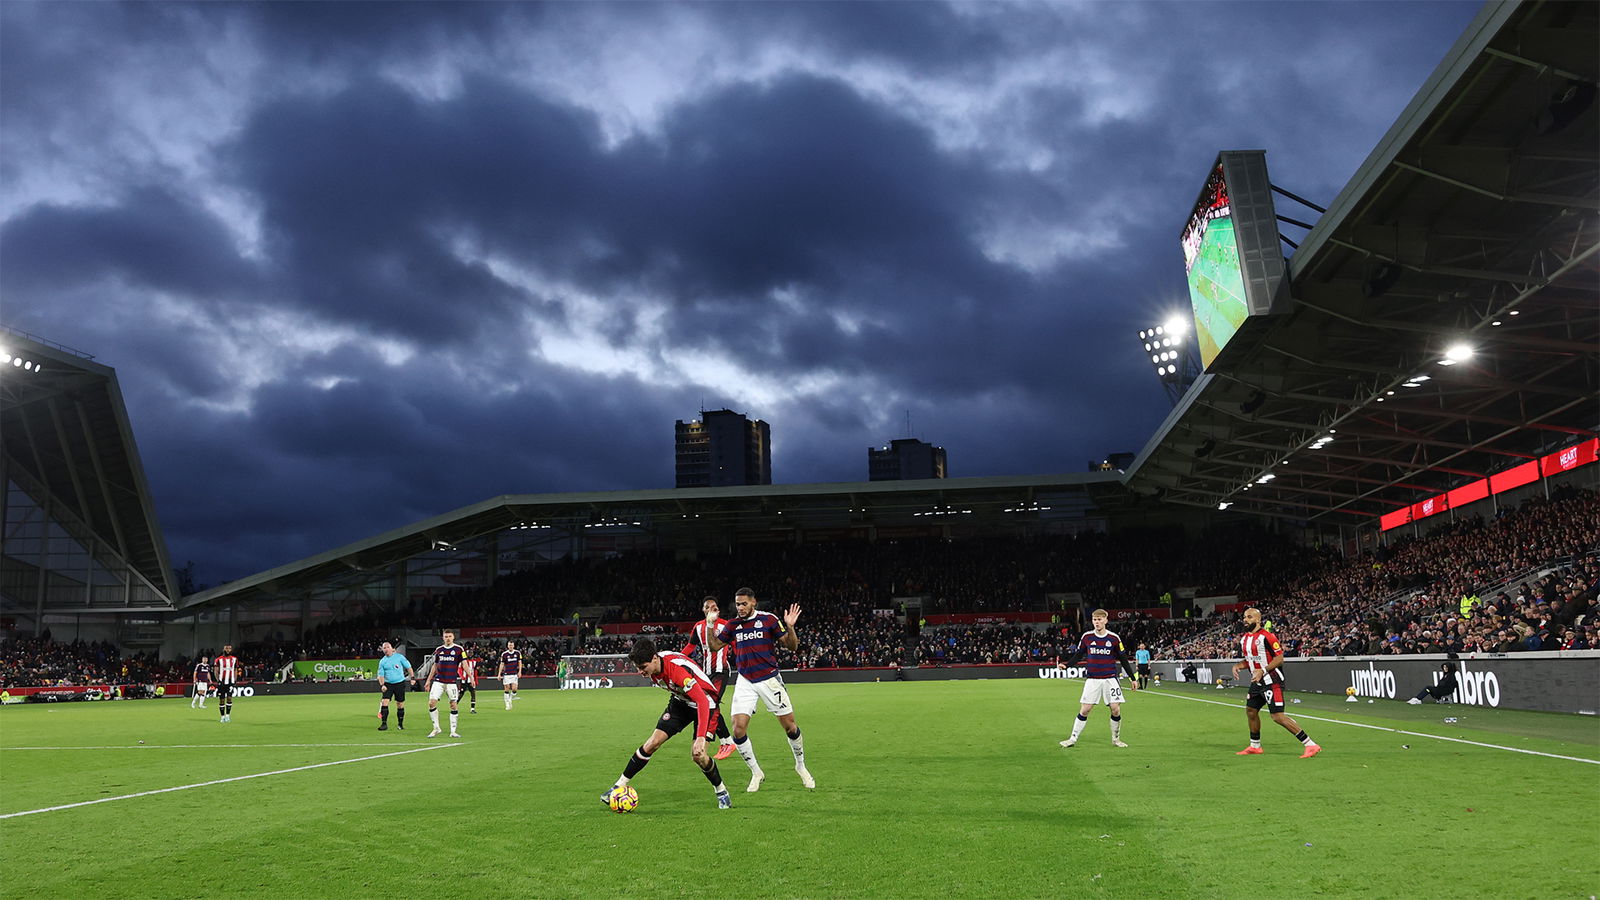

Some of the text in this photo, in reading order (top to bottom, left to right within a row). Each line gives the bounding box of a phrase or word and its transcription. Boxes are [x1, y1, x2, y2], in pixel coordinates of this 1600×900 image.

[1559, 447, 1577, 466] HEART
[1117, 611, 1140, 619] Gteh
[743, 630, 764, 641] sela
[1039, 667, 1087, 679] umbr
[1351, 661, 1396, 699] umbro
[774, 691, 782, 703] 7
[1110, 688, 1122, 697] 20
